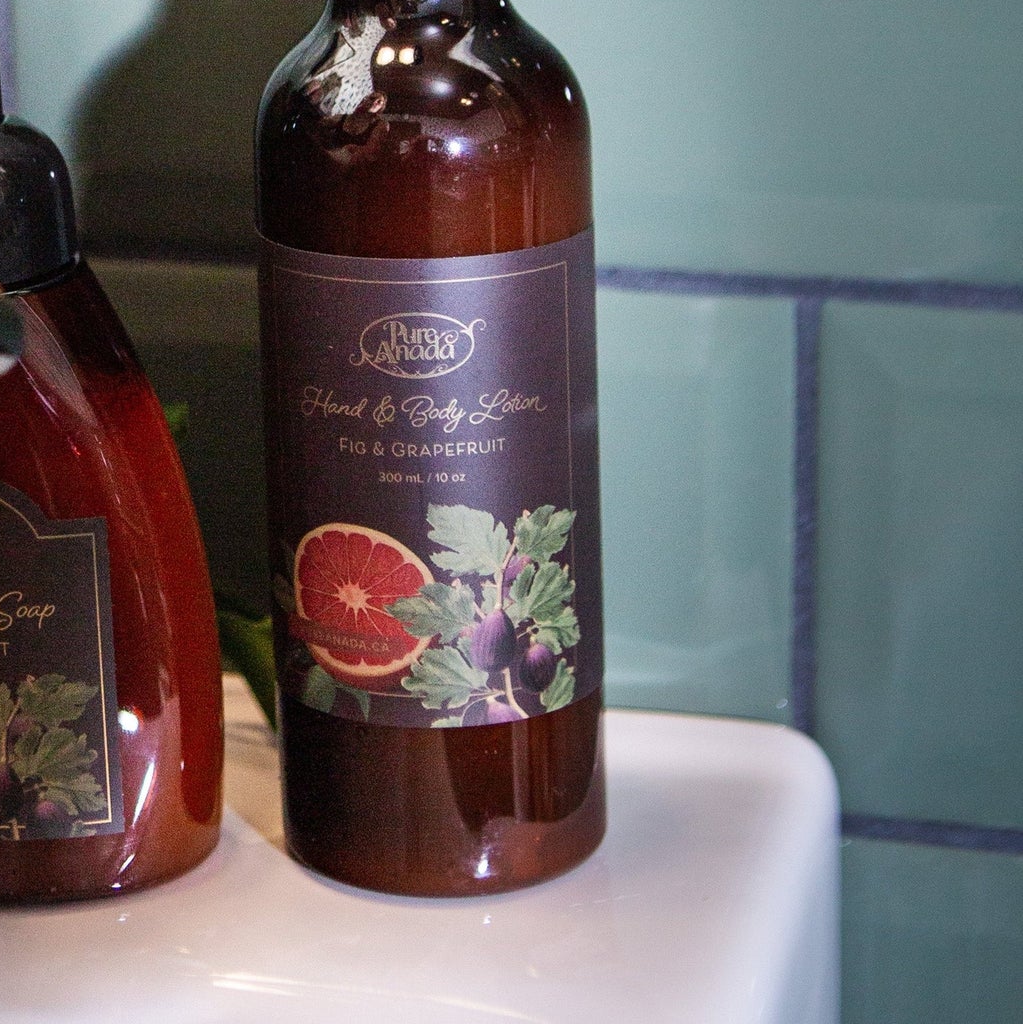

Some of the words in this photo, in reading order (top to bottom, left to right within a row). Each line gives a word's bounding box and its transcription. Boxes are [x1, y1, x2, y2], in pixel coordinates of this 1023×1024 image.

[383, 321, 439, 345] Pure
[375, 338, 455, 364] Anada
[301, 386, 366, 418] Hand
[372, 395, 396, 425] &
[401, 395, 467, 433] Body
[469, 389, 547, 425] Lotion
[373, 442, 385, 457] &
[391, 437, 506, 458] GRAPEFRUIT
[379, 472, 402, 484] 300
[405, 472, 424, 484] mL
[434, 472, 449, 484] 10
[451, 473, 467, 484] oz
